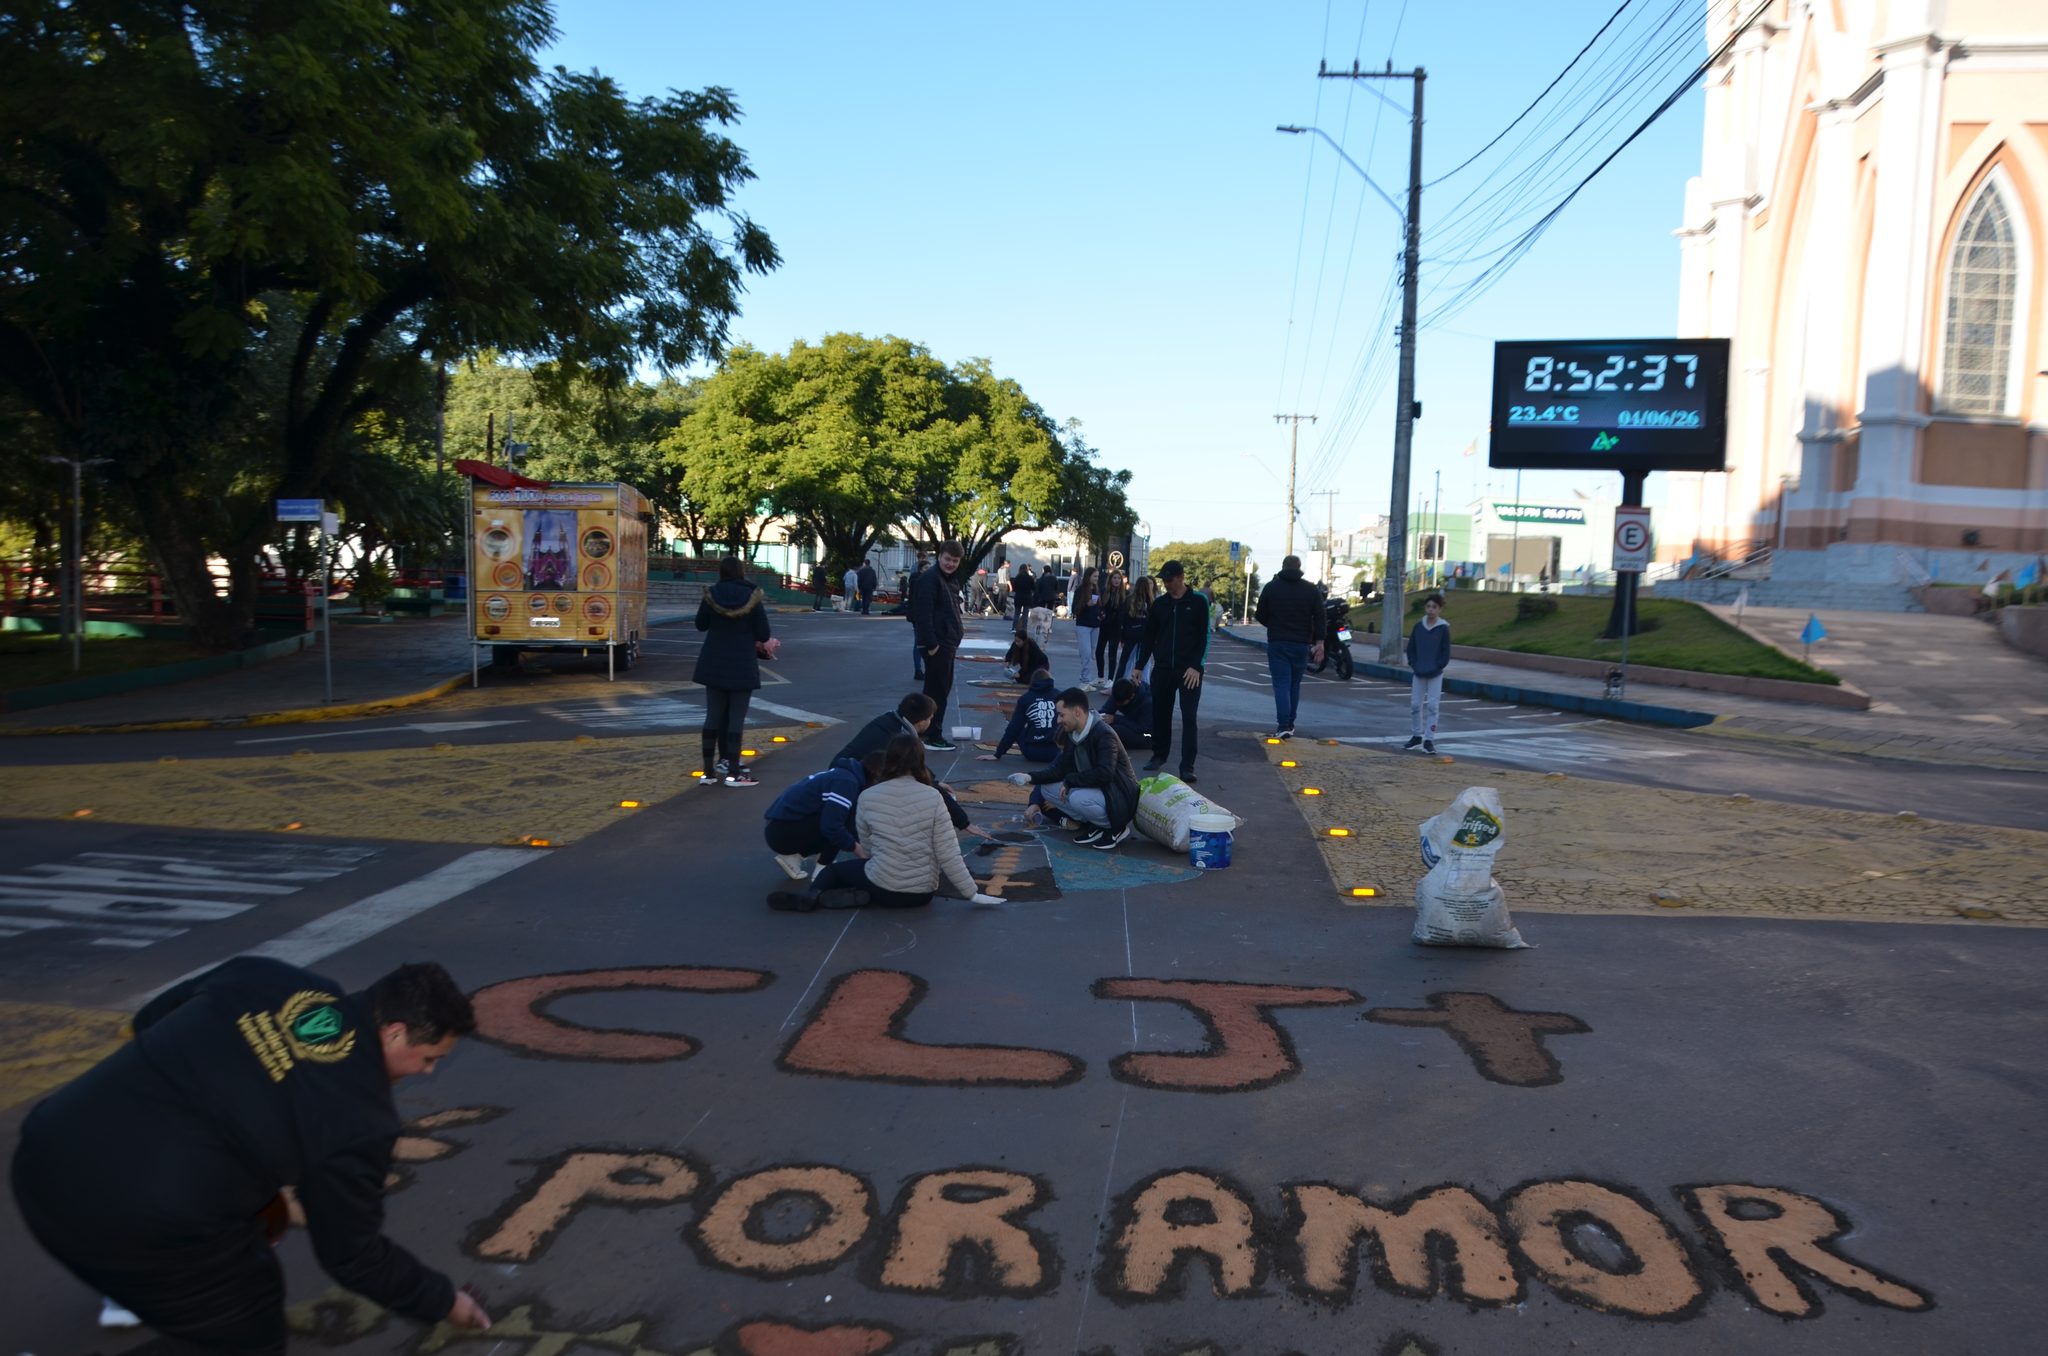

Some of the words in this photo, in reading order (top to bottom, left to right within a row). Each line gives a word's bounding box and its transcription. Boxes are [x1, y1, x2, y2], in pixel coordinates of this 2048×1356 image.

[1523, 354, 1699, 392] 8:52:37
[1508, 405, 1580, 422] 23.4°C
[1625, 526, 1639, 545] E
[1459, 819, 1497, 835] trifred
[254, 1009, 295, 1071] Medicina
[462, 1145, 1062, 1299] POR
[1095, 1166, 1934, 1320] AMOR
